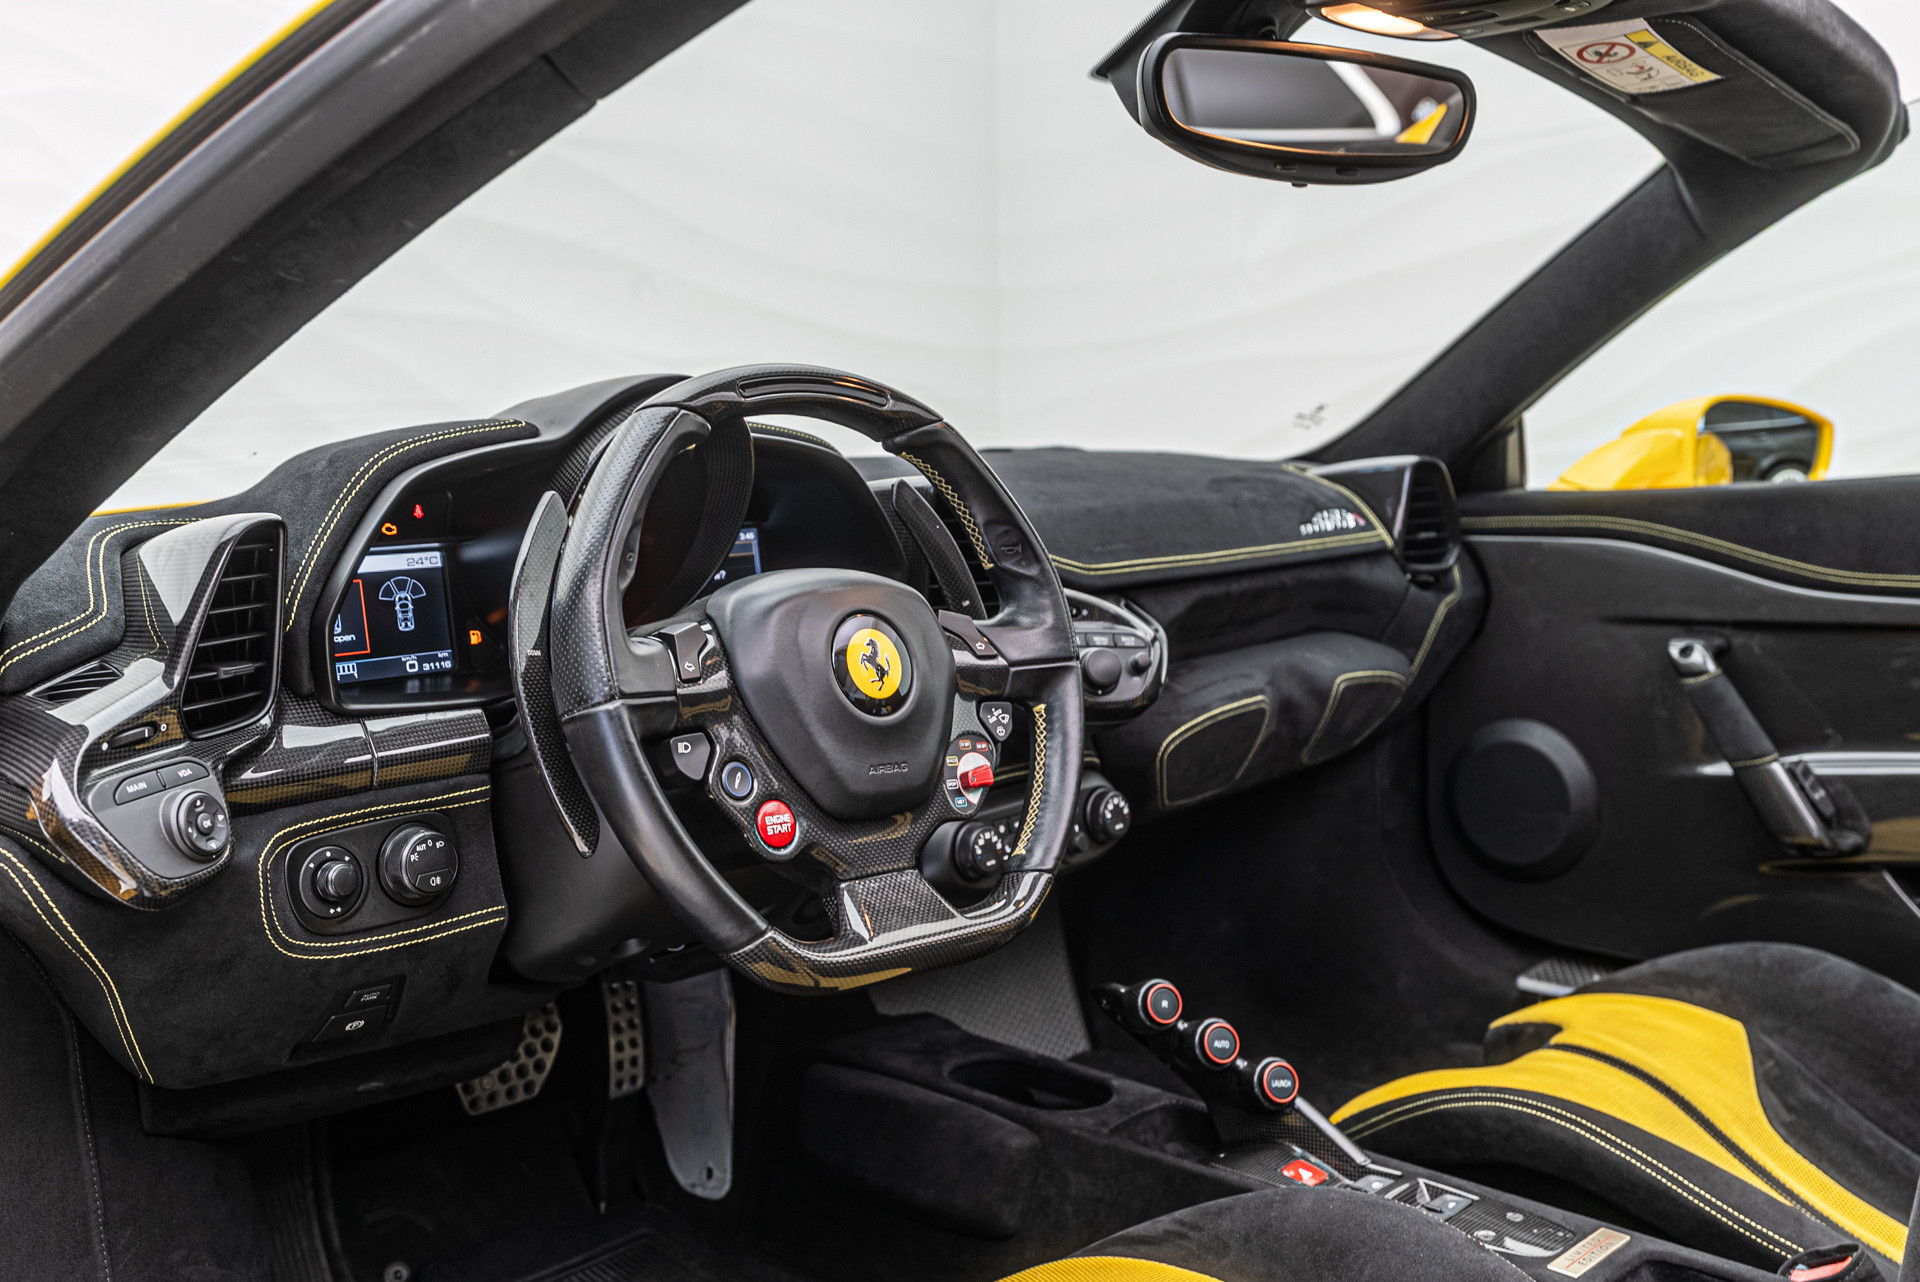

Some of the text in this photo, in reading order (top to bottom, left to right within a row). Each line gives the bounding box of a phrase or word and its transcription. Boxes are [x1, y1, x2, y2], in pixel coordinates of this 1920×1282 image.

[406, 555, 439, 567] 24°C
[333, 634, 356, 643] open
[177, 768, 193, 778] VDA
[869, 762, 909, 775] AIRBAG
[126, 781, 148, 793] MAIN
[765, 814, 791, 825] ENGINE
[767, 823, 791, 835] START
[1161, 1000, 1169, 1009] R
[1213, 1039, 1230, 1050] AUTO
[1271, 1078, 1292, 1088] LAUNCH
